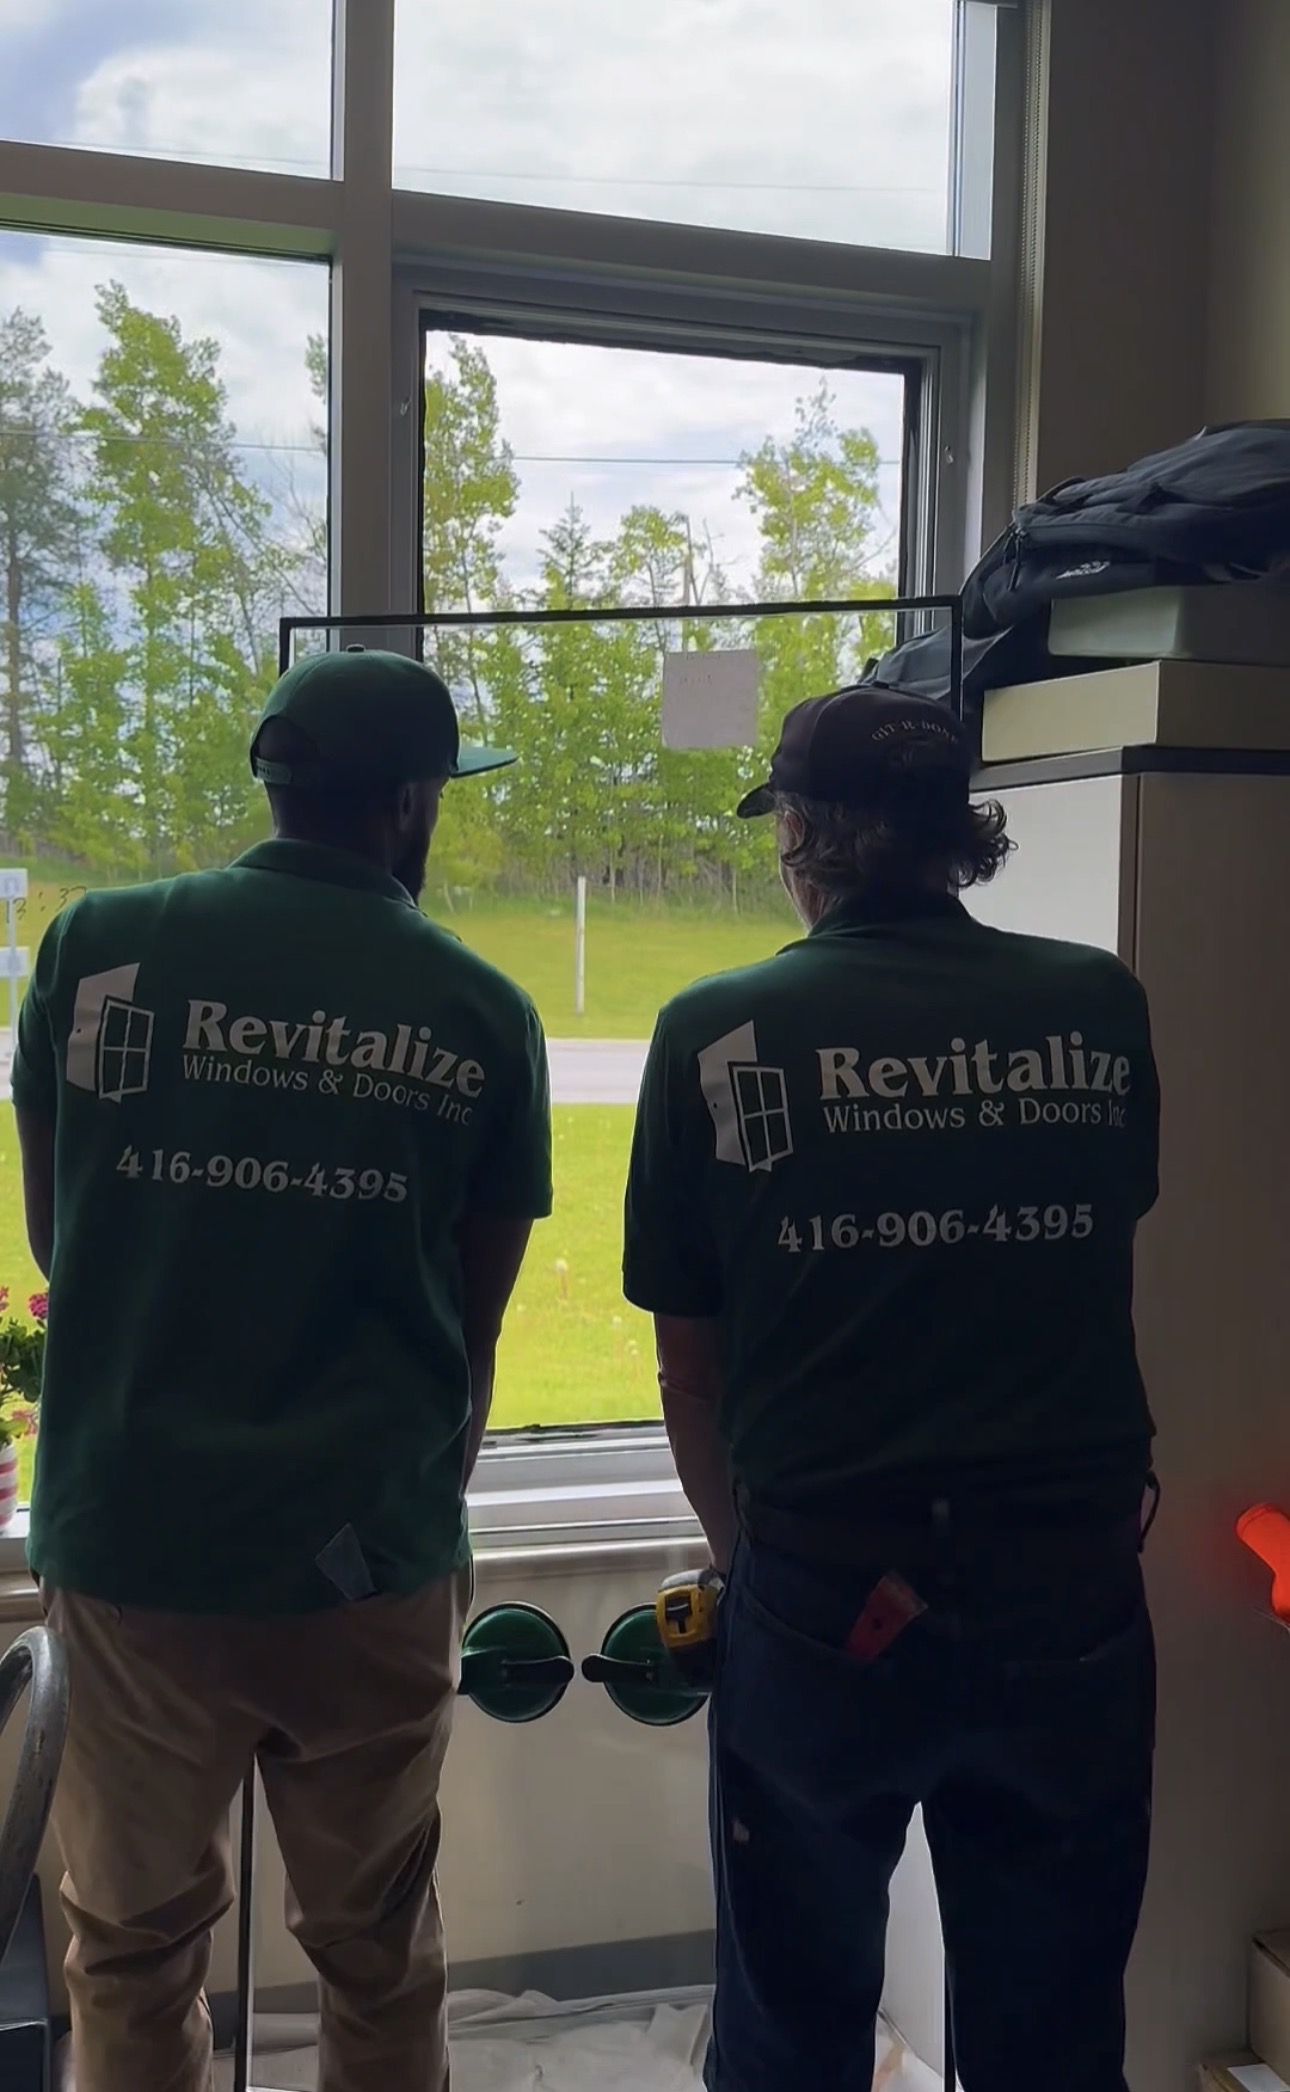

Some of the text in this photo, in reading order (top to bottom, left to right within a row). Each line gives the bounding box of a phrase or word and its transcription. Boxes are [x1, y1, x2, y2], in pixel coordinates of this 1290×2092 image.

[182, 999, 486, 1098] Revitalize
[815, 1030, 1132, 1100] Revitalize
[182, 1054, 474, 1126] Windows & Doors Inc
[823, 1102, 966, 1134] Windows
[978, 1099, 1005, 1127] &
[1018, 1097, 1102, 1126] Doors
[115, 1144, 409, 1202] 416-906-4395
[777, 1203, 1095, 1254] 416-906-4395
